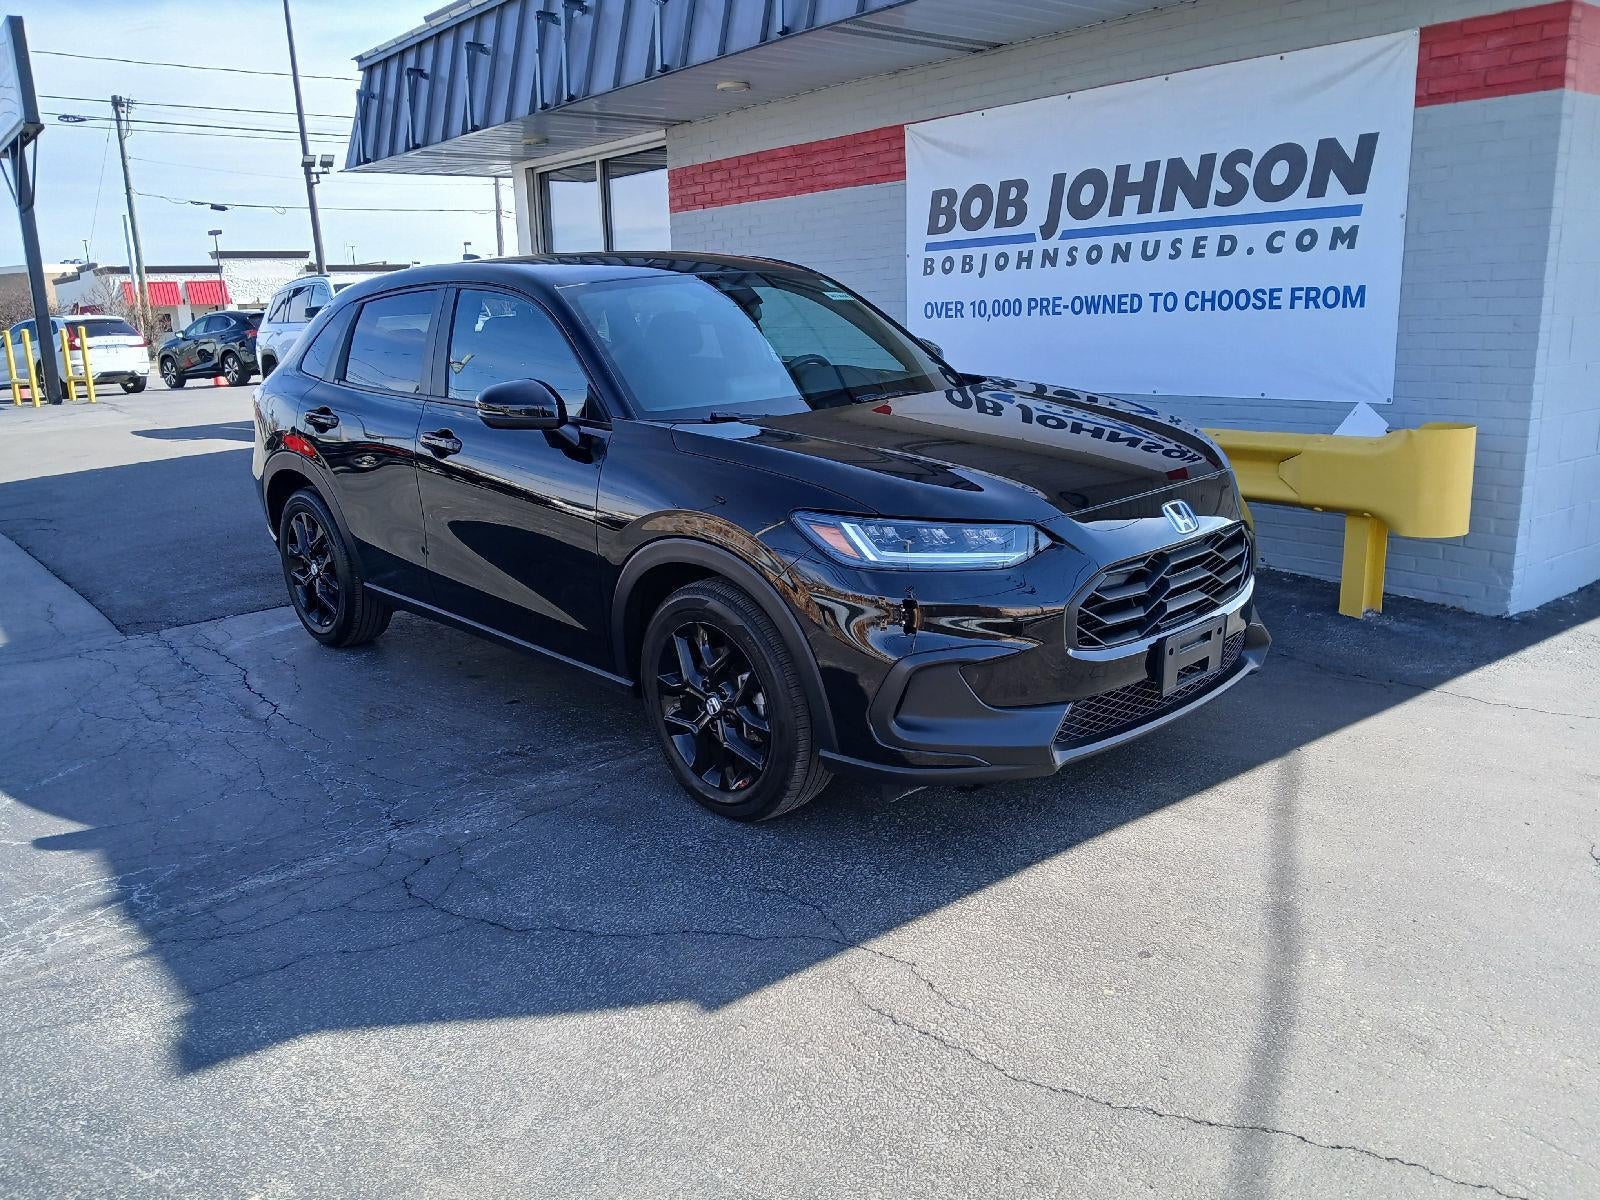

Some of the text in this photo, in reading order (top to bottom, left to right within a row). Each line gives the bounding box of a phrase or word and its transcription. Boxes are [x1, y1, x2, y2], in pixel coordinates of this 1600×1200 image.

[927, 131, 1380, 240] BOB JOHNSON
[923, 224, 1360, 278] BOBJOHNSONUSED.COM
[924, 284, 1366, 322] OVER 10,000 PRE-OWNED TO CHOOSE FROM
